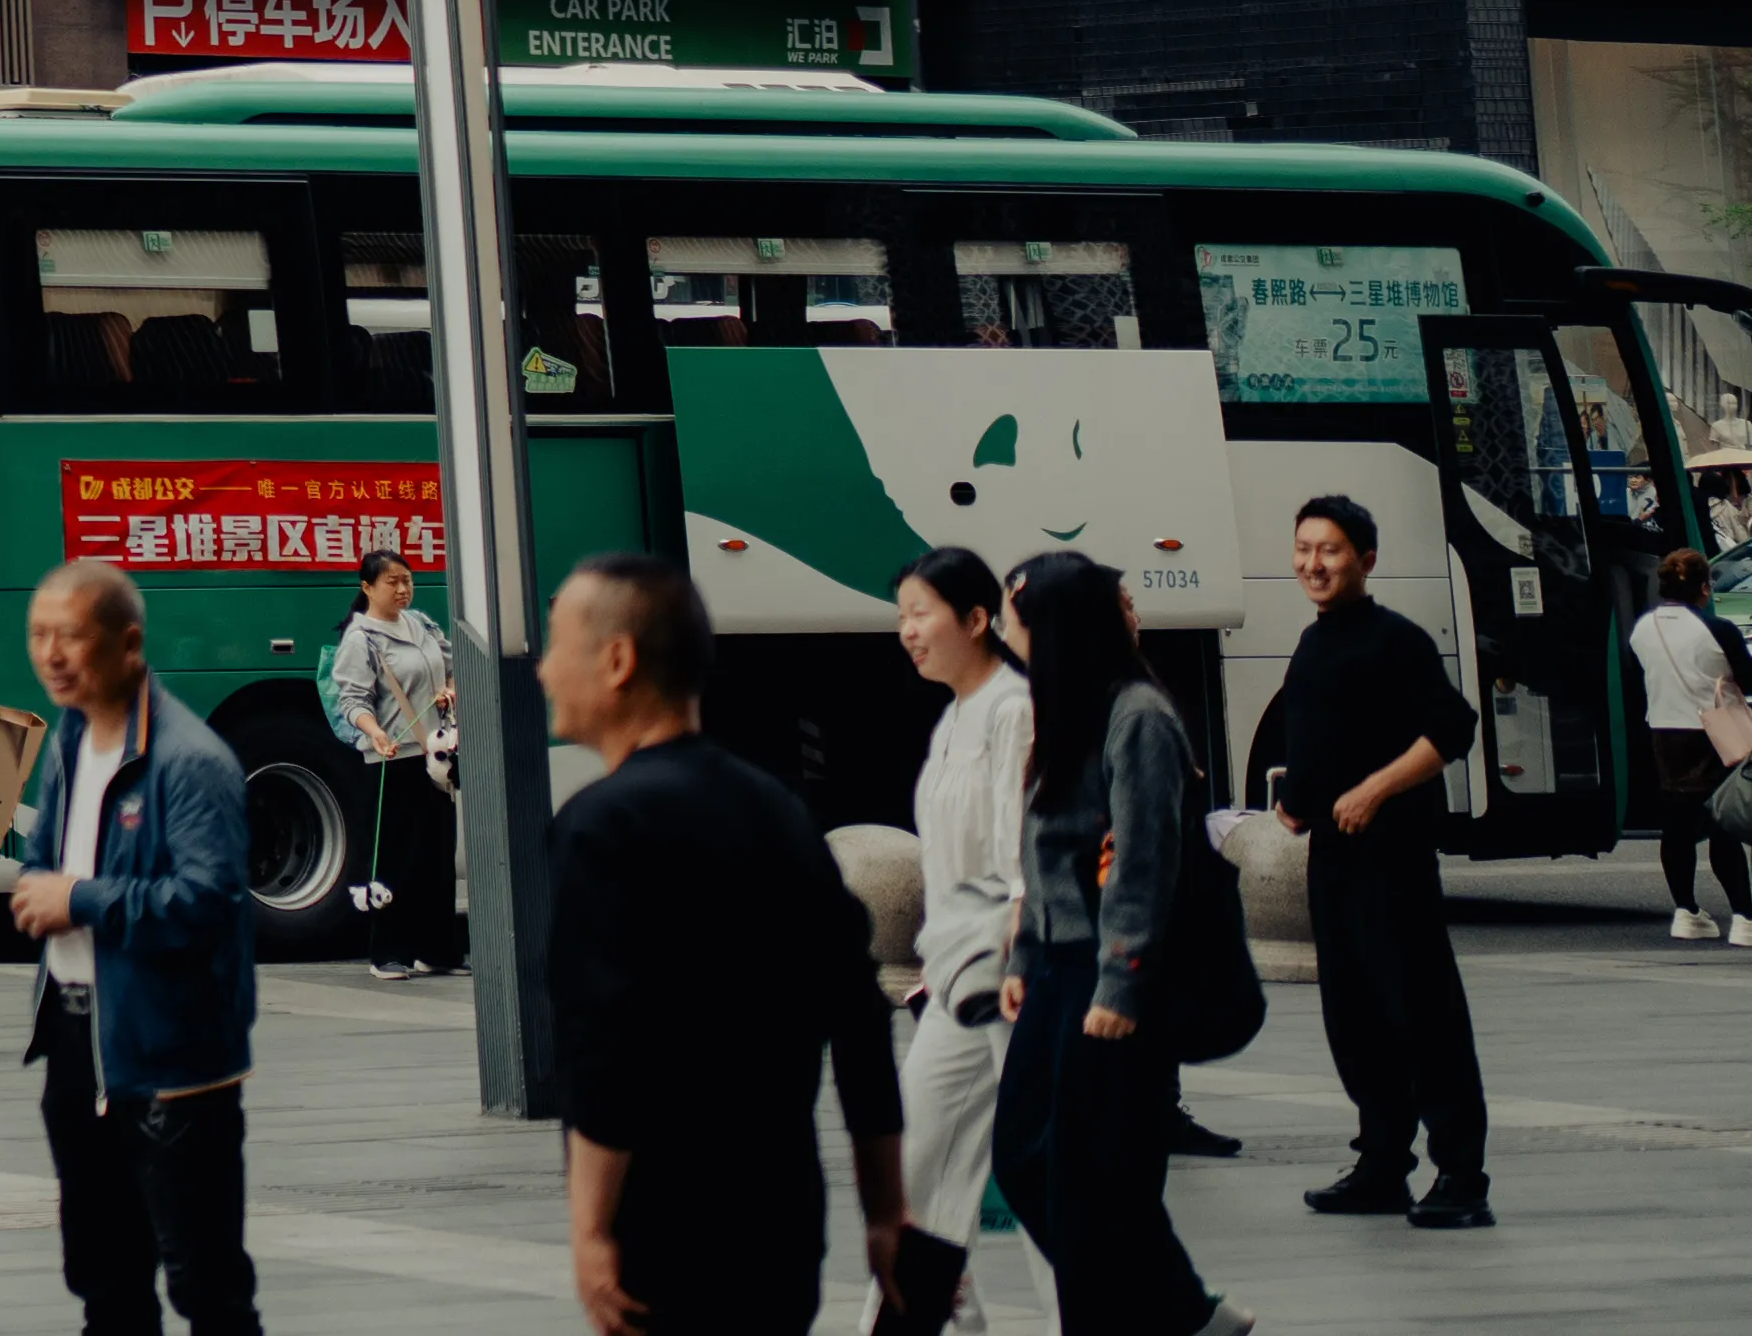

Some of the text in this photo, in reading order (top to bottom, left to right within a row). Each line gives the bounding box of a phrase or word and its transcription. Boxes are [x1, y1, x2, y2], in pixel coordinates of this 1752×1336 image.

[528, 29, 674, 61] ENTERANCE
[786, 16, 838, 50] 汇泊
[786, 51, 838, 65] WE PARK
[1251, 277, 1460, 309] 春熙路 三星堆博物馆
[1294, 318, 1398, 362] 车票 25 元
[111, 477, 439, 502] 成都公交 唯一官方认证线路
[78, 513, 445, 564] 三星堆景区直通车
[1143, 570, 1201, 589] 57034
